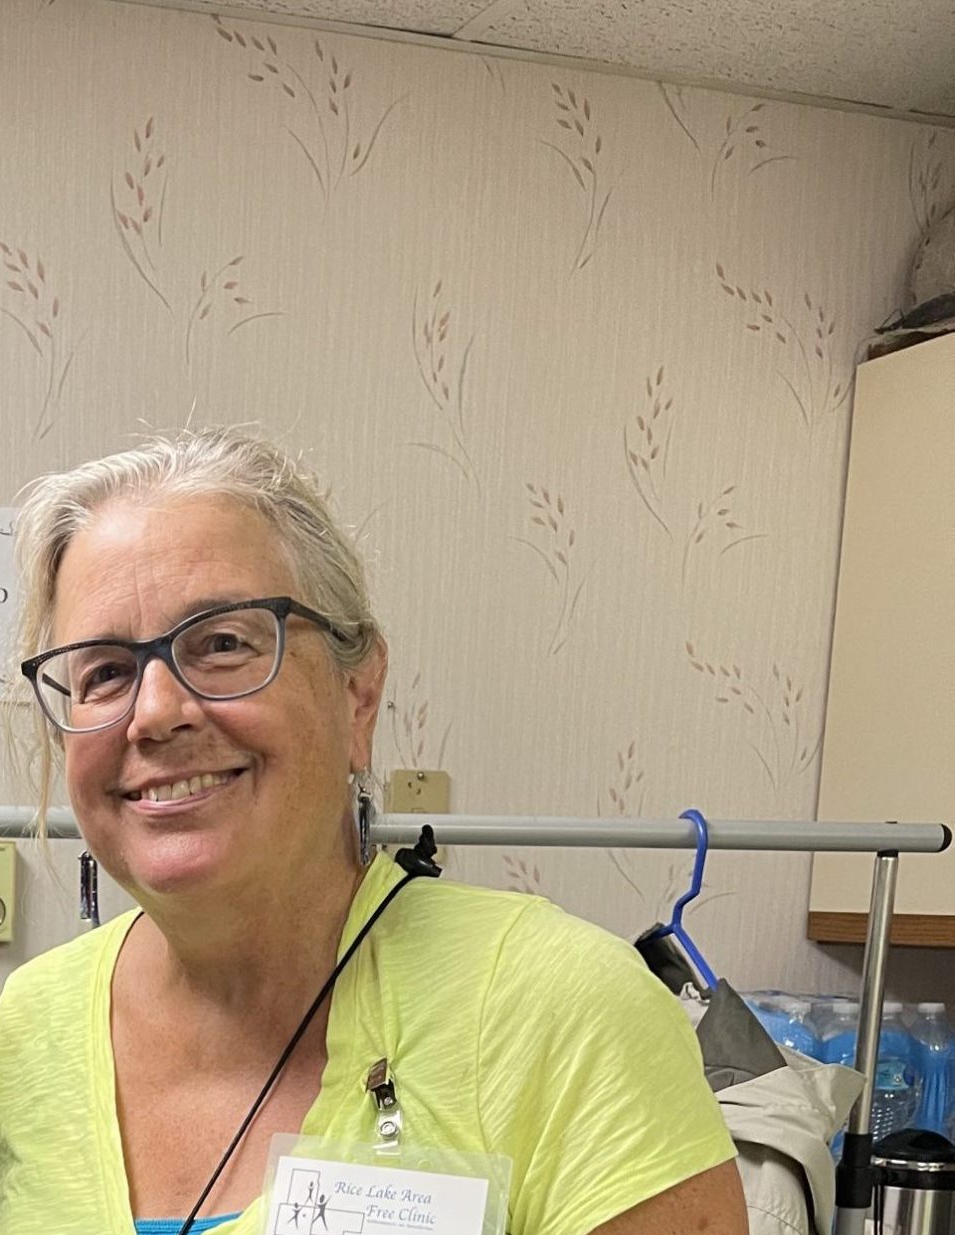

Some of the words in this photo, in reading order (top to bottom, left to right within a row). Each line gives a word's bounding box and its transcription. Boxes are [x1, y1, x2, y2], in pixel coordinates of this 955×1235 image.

[335, 1181, 363, 1196] Rice
[366, 1184, 397, 1201] Lake
[401, 1189, 432, 1204] Area
[366, 1204, 395, 1220] Free
[399, 1206, 437, 1225] Clinic
